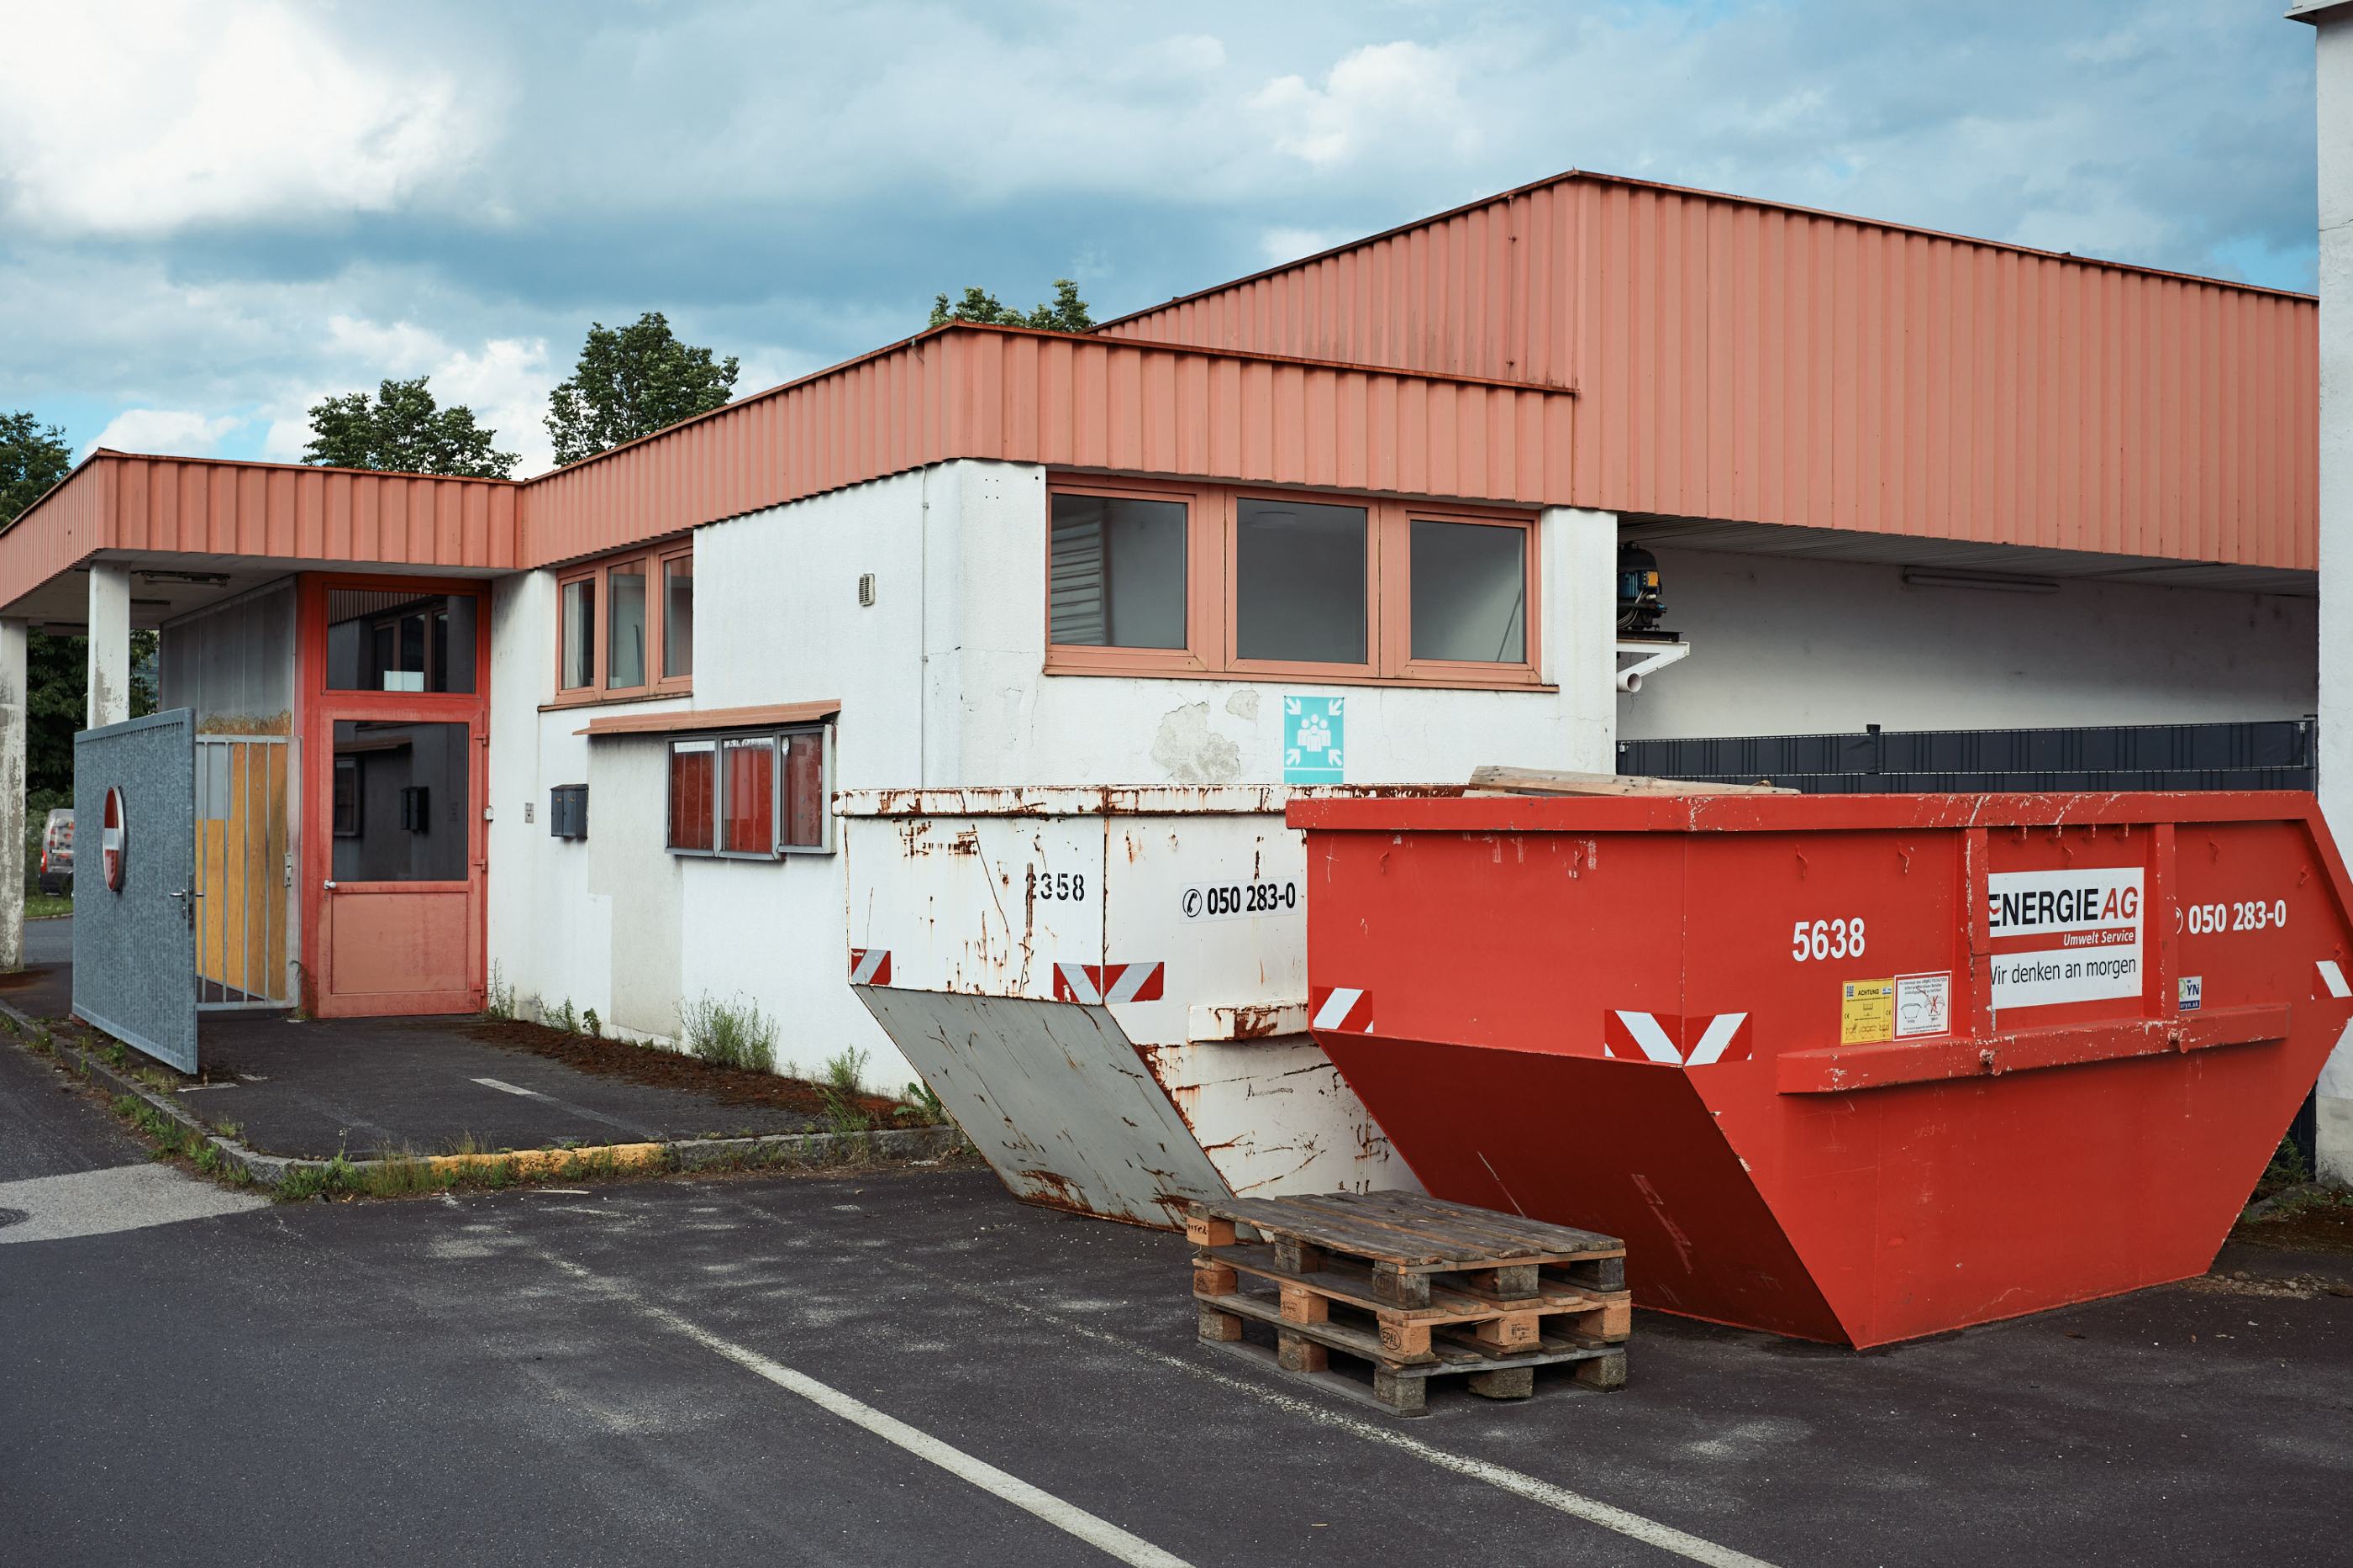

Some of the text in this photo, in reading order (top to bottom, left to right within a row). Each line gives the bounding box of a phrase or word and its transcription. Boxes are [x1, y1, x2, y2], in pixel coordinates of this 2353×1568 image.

[1025, 872, 1085, 902] 2358
[1207, 881, 1296, 915] 050 283-0
[2100, 886, 2139, 921] AG
[2188, 899, 2287, 934] 050 283-0
[1792, 917, 1866, 962] 5638
[2063, 929, 2135, 946] Umwelt Service
[2011, 960, 2061, 984] denken
[2065, 962, 2081, 979] an
[2087, 957, 2136, 979] morgen
[1857, 988, 1879, 997] ACHTUNG
[2179, 1001, 2199, 1010] aryn.sk
[1382, 1330, 1398, 1348] EPAL
